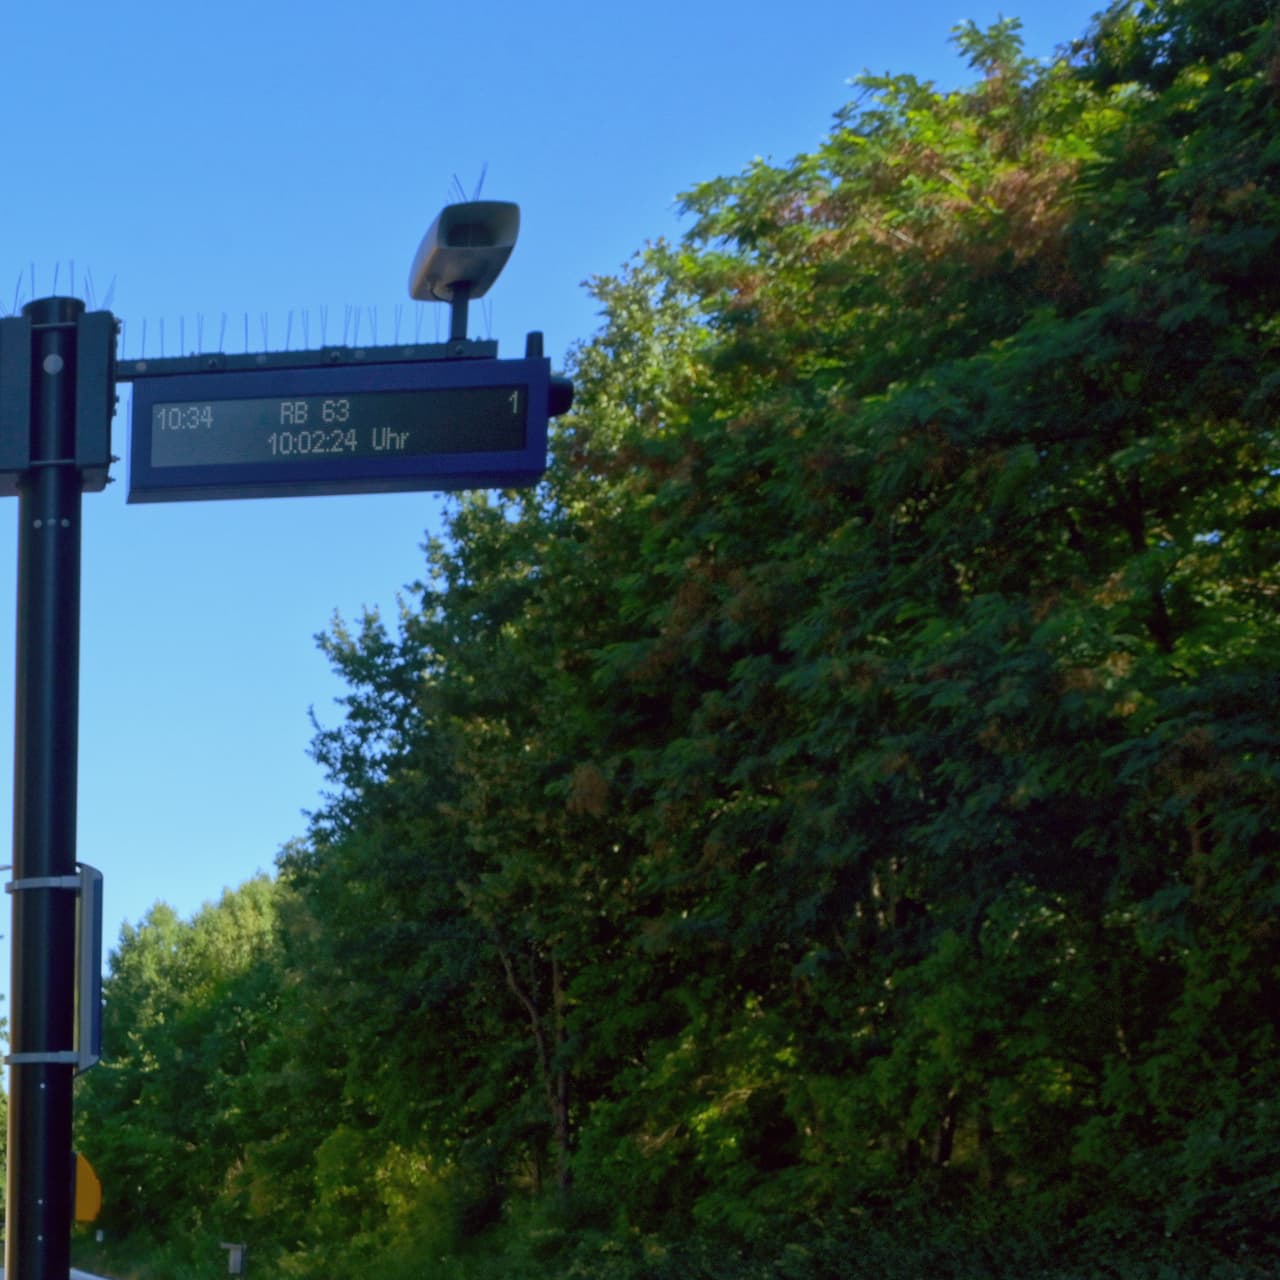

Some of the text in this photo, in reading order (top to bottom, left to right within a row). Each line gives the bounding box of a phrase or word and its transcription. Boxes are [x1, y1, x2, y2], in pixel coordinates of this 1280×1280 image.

[280, 400, 350, 425] RB 63
[508, 391, 519, 414] 1
[157, 406, 214, 431] 10:34
[268, 427, 410, 455] 10:02:24 Uhr
